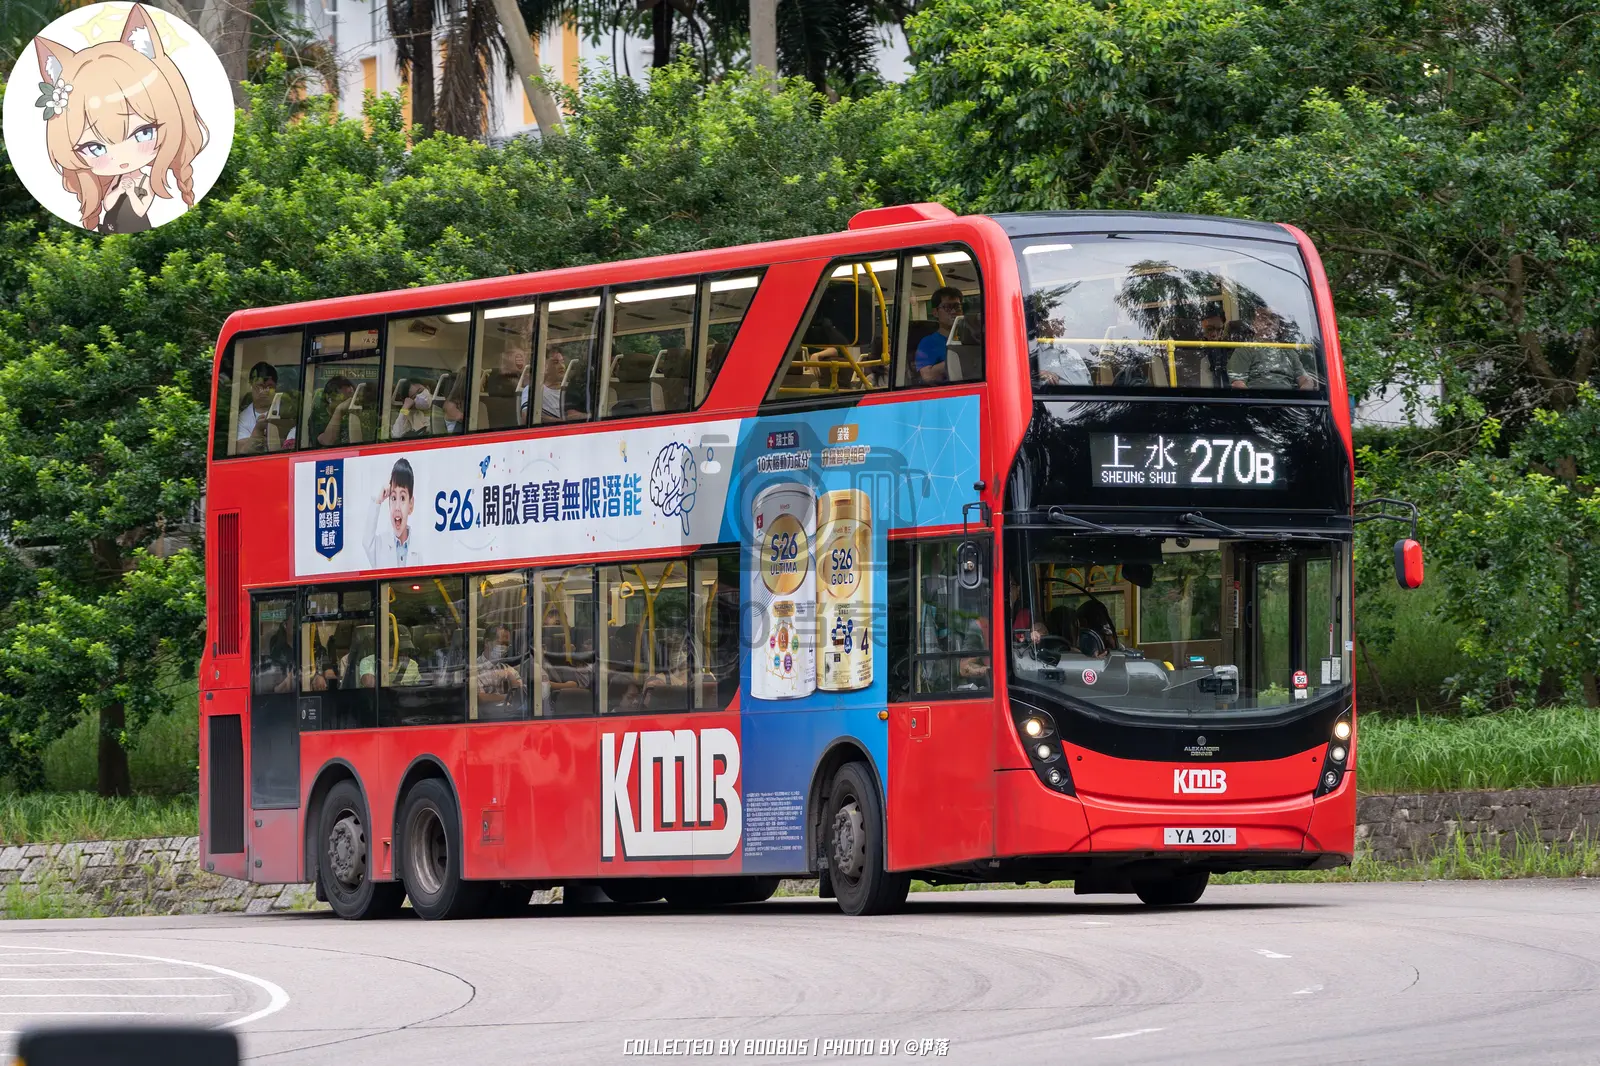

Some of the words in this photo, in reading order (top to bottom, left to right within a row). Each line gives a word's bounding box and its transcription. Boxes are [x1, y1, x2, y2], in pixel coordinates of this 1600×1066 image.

[775, 432, 795, 447] 瑞士版
[1101, 434, 1178, 469] 上水
[1190, 439, 1275, 484] 270B
[1101, 471, 1145, 484] SHEUNG
[1149, 471, 1177, 484] SHUI
[482, 473, 643, 528] 開啟寶寶無限潛能
[321, 530, 336, 547] 權威
[770, 561, 798, 576] ULTIMA
[830, 572, 854, 585] GOLD
[860, 627, 870, 655] 4
[1173, 769, 1227, 794] KMB
[601, 727, 742, 861] KMB
[1175, 829, 1195, 843] YA
[1202, 829, 1225, 843] 201
